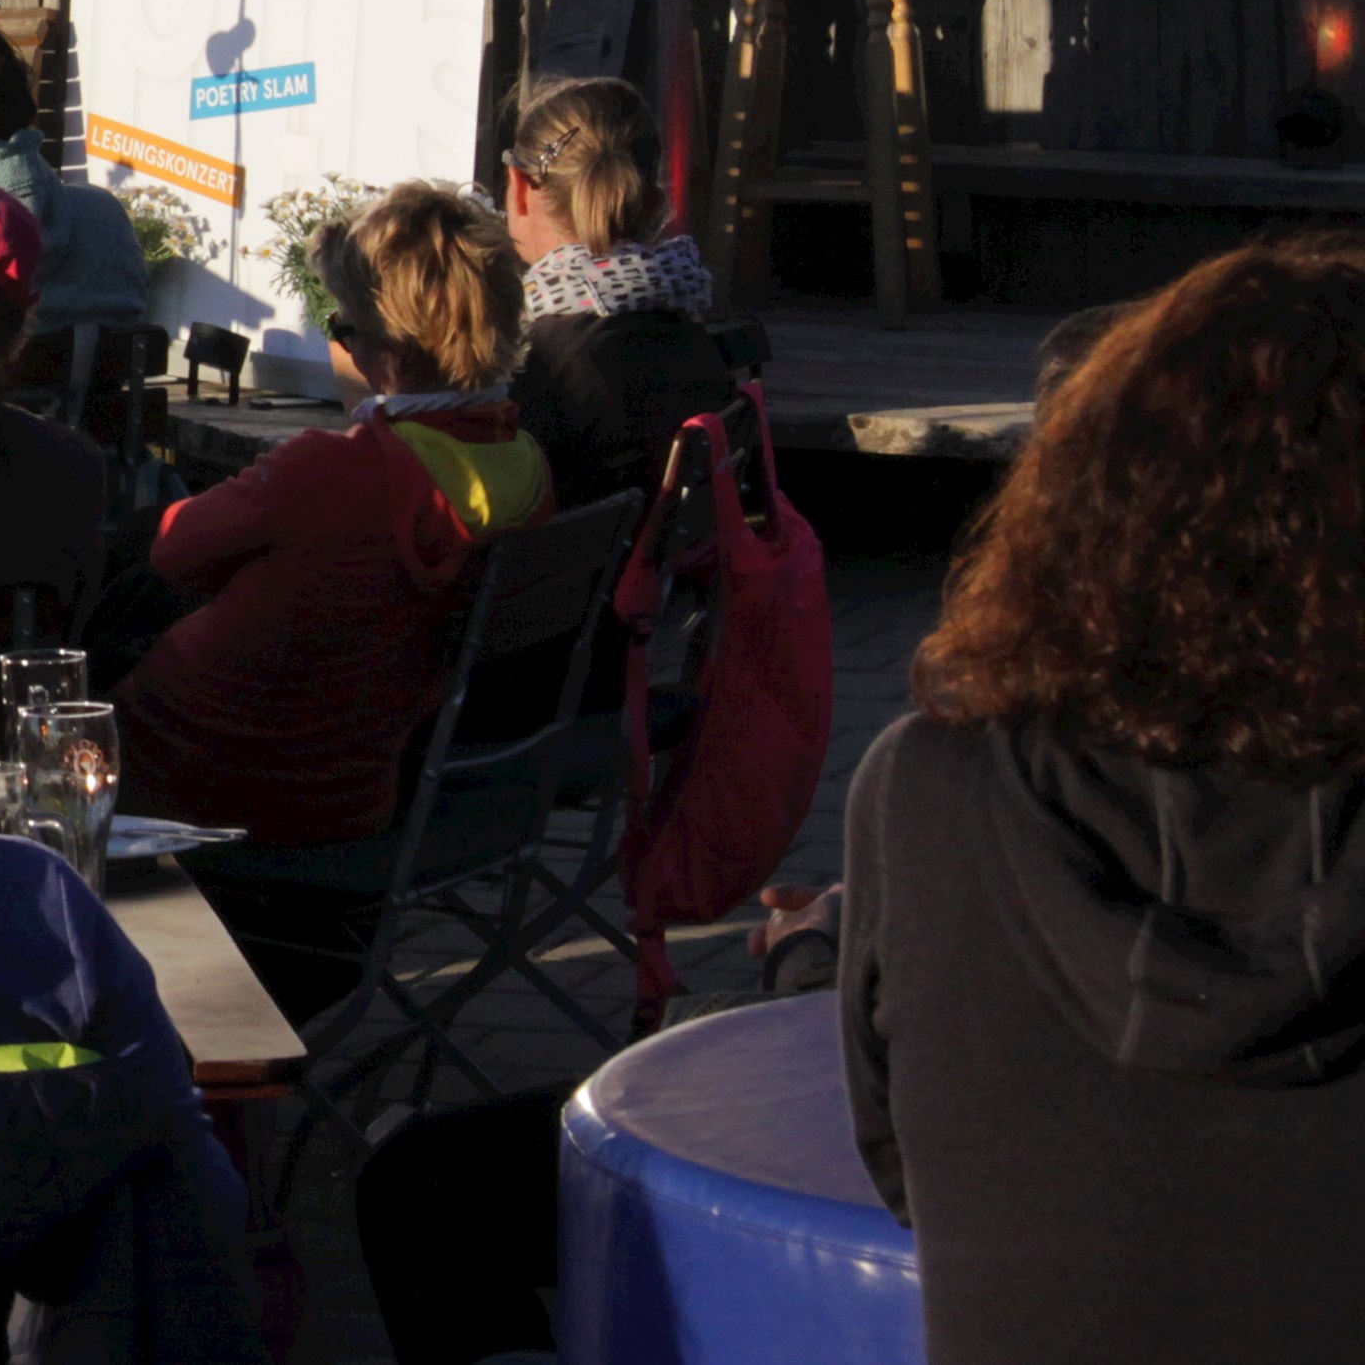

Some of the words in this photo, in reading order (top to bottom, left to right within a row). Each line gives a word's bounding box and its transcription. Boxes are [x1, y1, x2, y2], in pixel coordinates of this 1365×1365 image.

[195, 81, 258, 109] POETRY
[263, 74, 308, 99] SLAM
[91, 126, 238, 195] LESUNGSKONZERT
